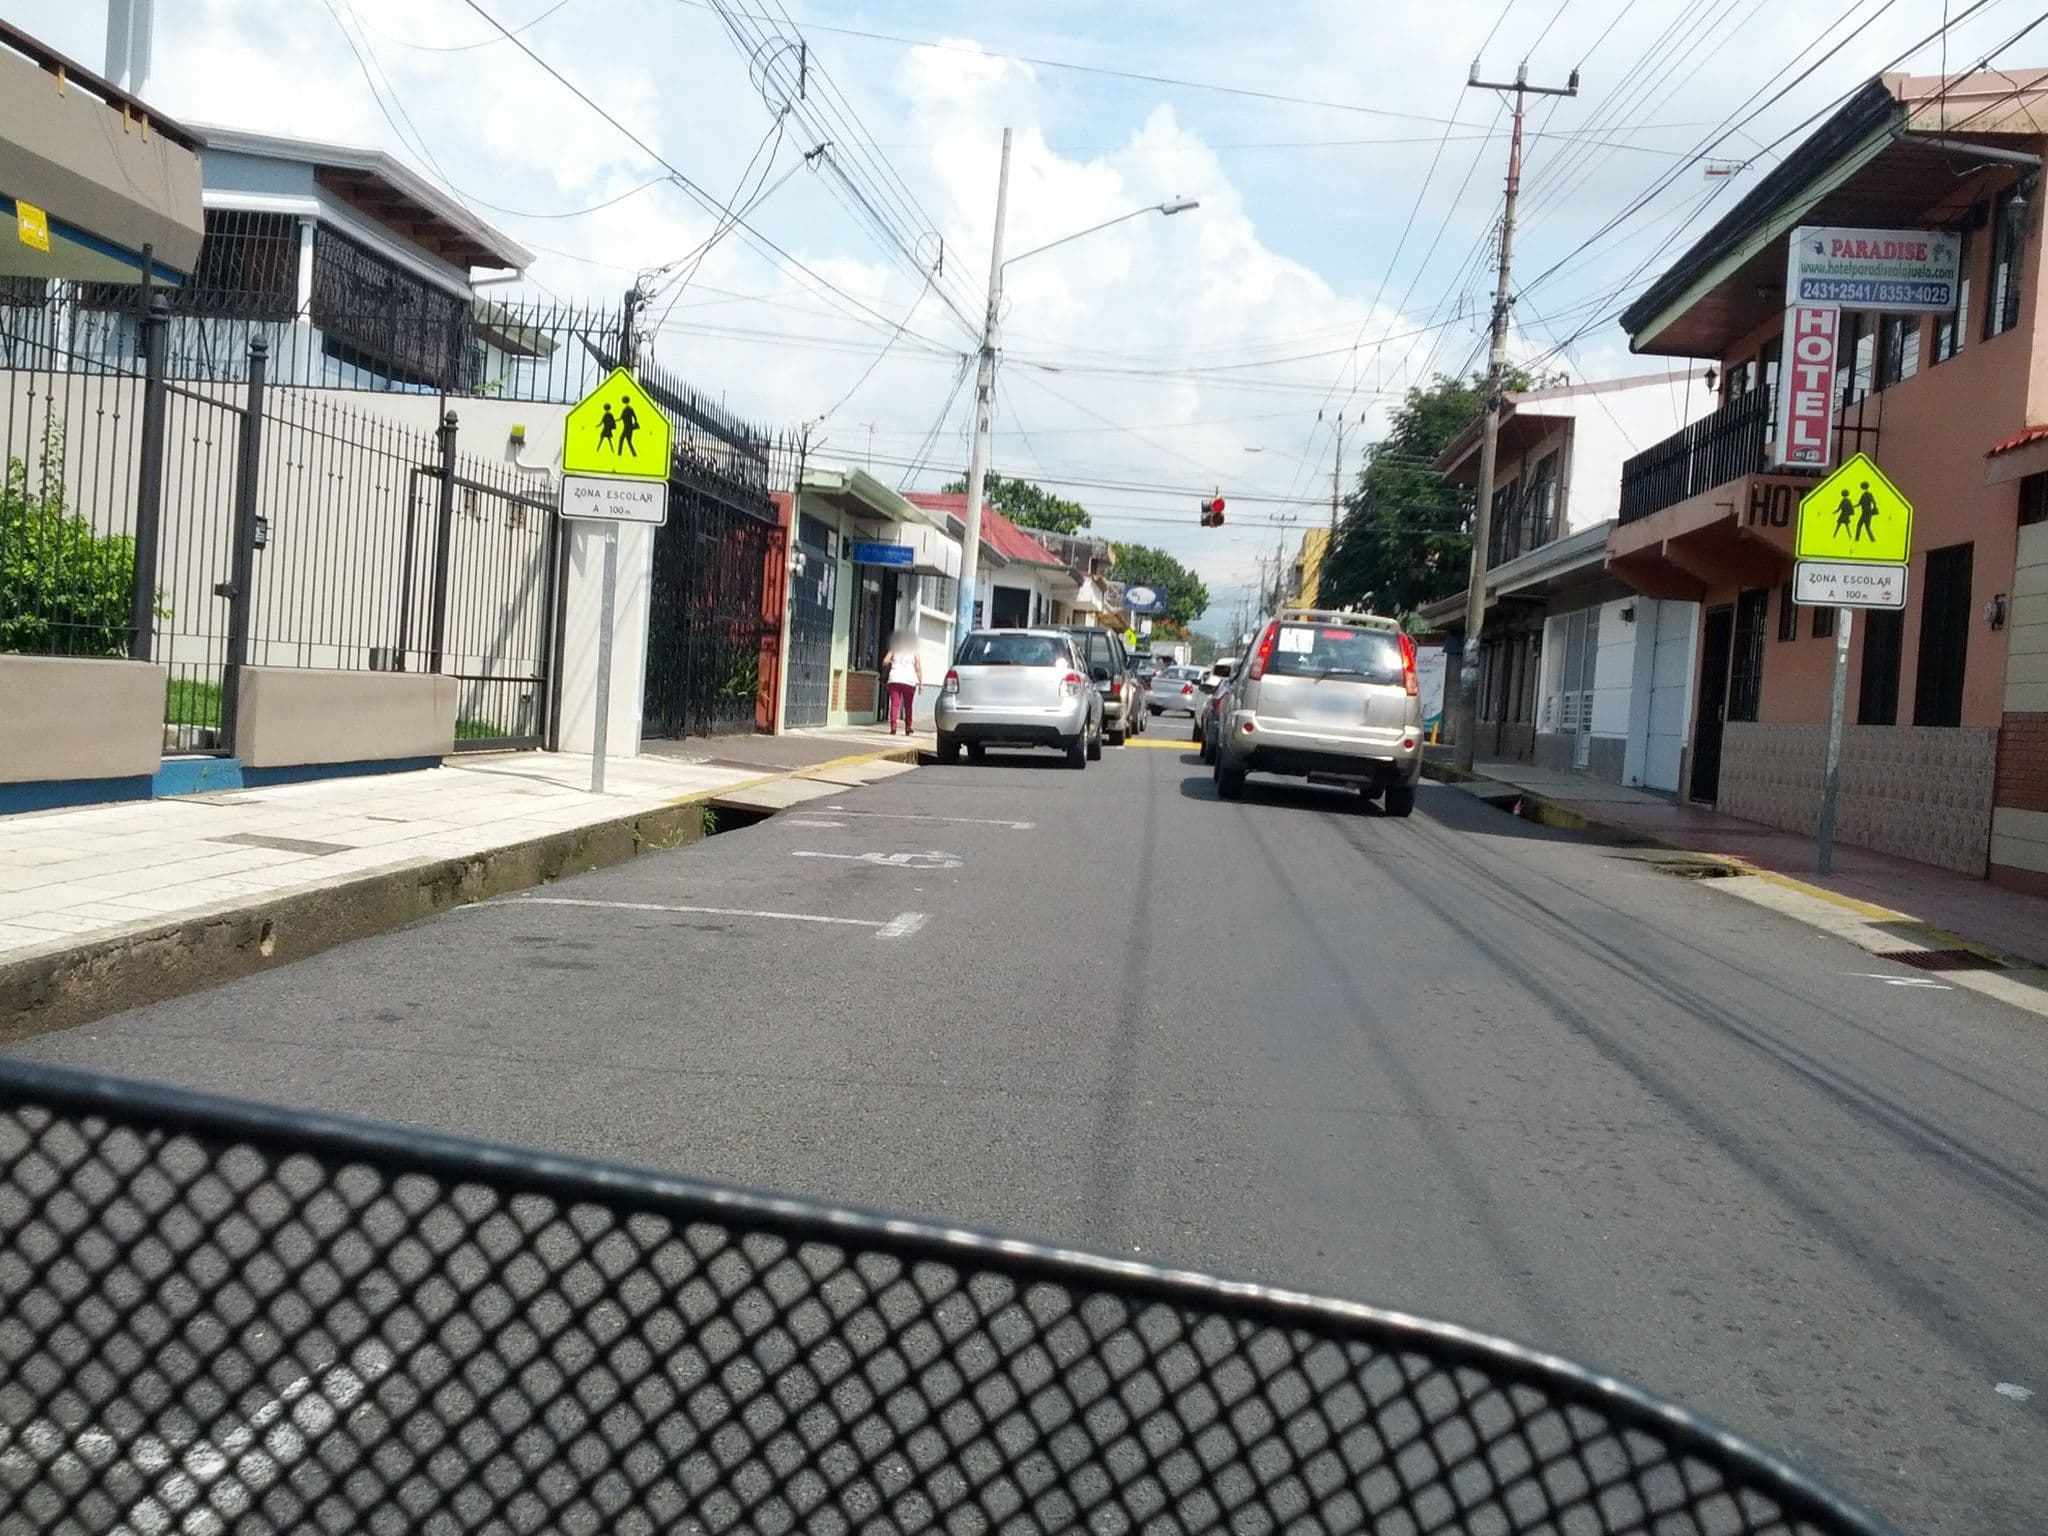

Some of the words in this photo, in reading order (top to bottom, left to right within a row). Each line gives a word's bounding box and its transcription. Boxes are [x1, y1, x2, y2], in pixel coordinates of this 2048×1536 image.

[1831, 239, 1928, 261] PARADISE
[1801, 260, 1954, 279] www.hotelparadisealajuela.com
[1794, 308, 1834, 446] HOTEL
[574, 487, 601, 499] ZONA
[606, 490, 653, 502] ESCOLAR
[593, 504, 599, 513] A
[1809, 573, 1837, 584] ZONA
[1843, 575, 1892, 587] ESCOLAR
[1828, 589, 1836, 598] A
